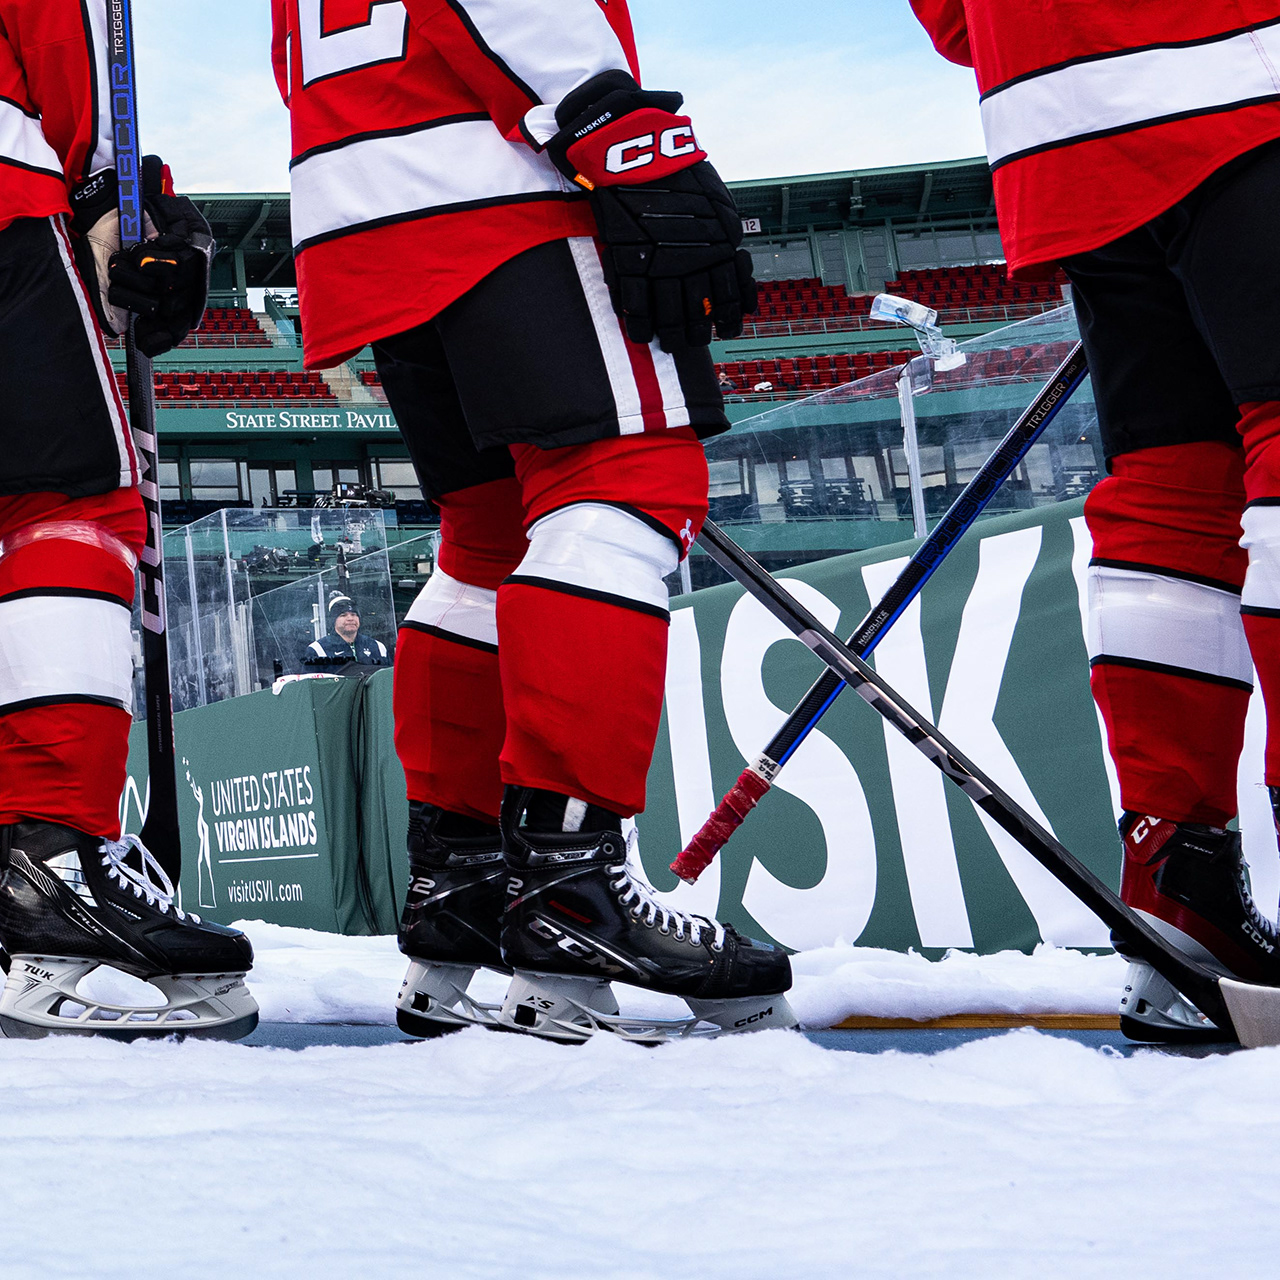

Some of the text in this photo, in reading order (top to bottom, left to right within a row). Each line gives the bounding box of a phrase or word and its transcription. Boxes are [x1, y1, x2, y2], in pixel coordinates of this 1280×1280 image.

[574, 111, 612, 138] HUSKIES
[111, 62, 142, 242] RIBCOR
[605, 125, 700, 174] CC
[74, 175, 105, 201] CCM
[744, 220, 757, 232] 12
[225, 411, 277, 429] STATE
[345, 411, 399, 429] PAVIL
[1025, 381, 1067, 430] TRIGGER
[857, 609, 889, 645] NANOLITE
[210, 765, 314, 817] UNITED STATES
[214, 810, 318, 853] VIRGIN ISLANDS
[227, 879, 304, 903] visitUSVI.com
[70, 905, 105, 937] TRUE
[1240, 919, 1276, 955] CCM
[528, 916, 625, 973] CCM
[733, 1006, 774, 1029] CCM
